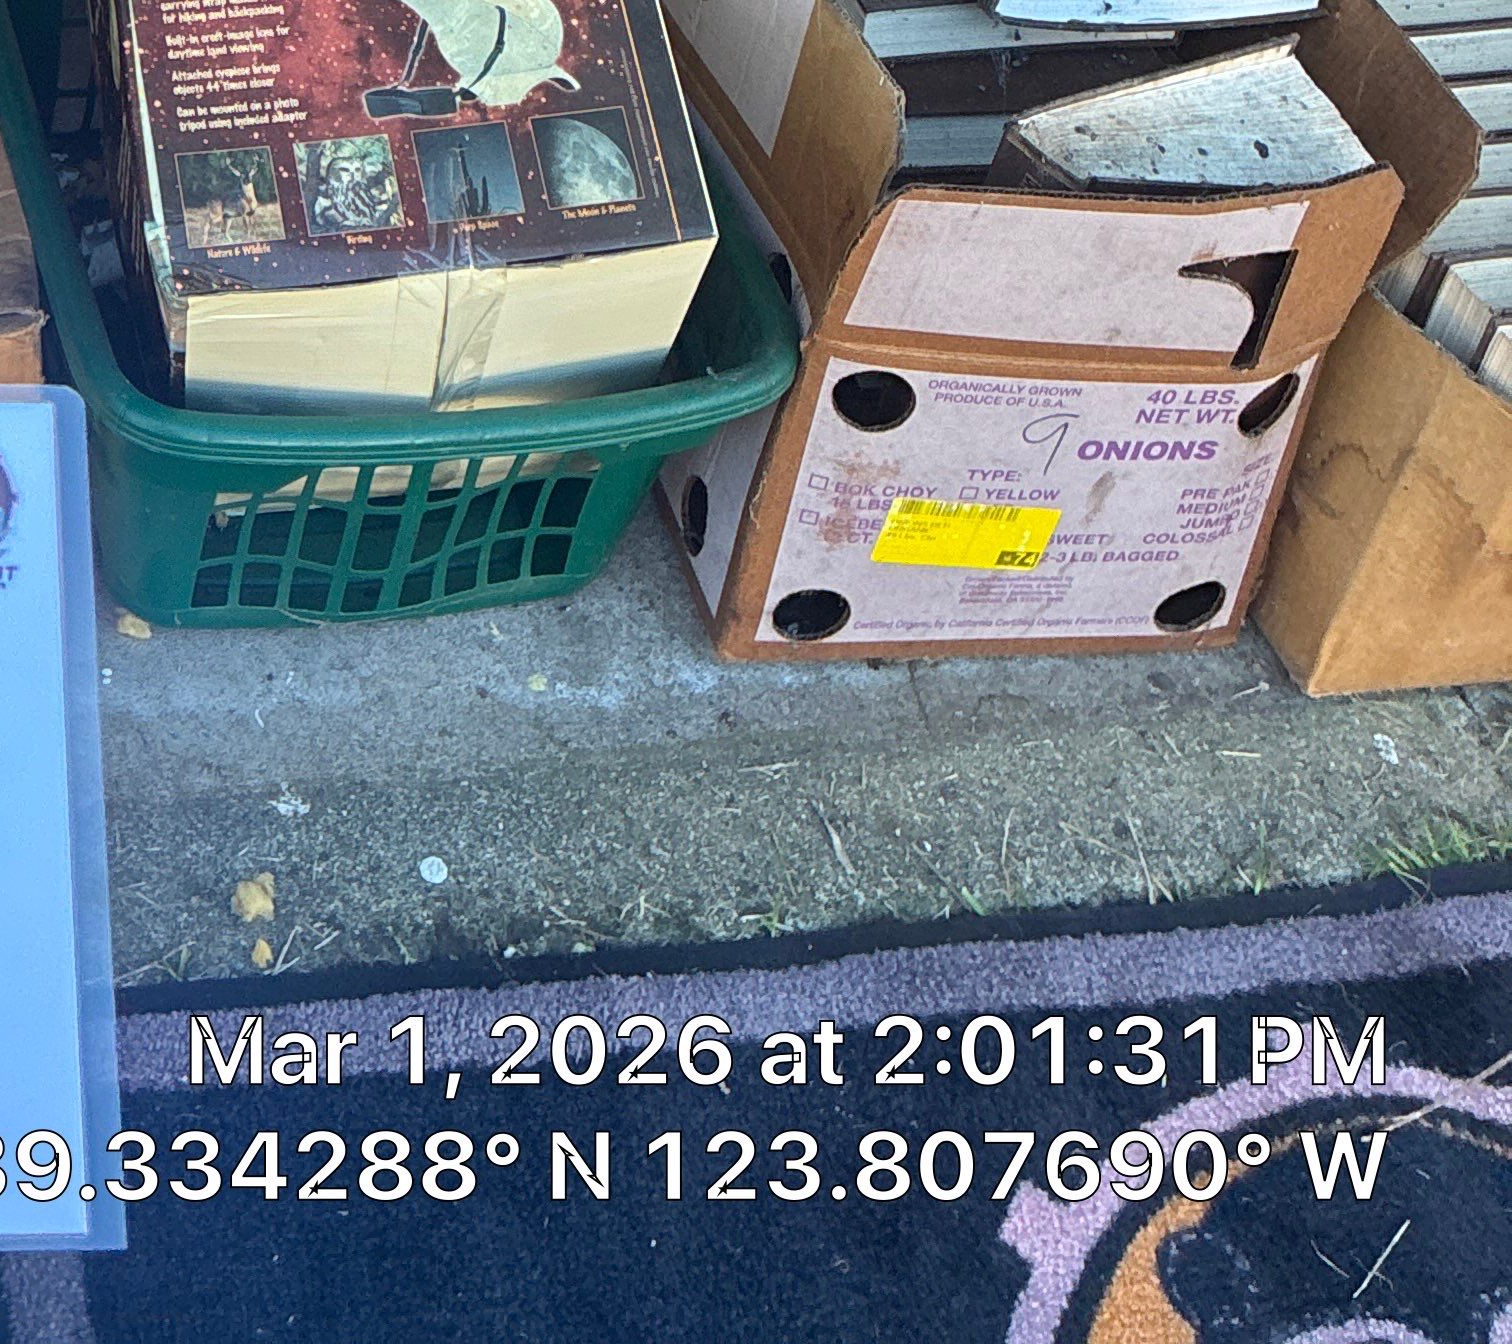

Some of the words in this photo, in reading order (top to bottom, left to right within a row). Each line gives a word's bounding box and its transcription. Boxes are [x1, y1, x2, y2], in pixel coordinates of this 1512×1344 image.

[160, 0, 201, 12] carrying
[162, 13, 176, 24] for
[178, 10, 207, 24] hiking
[208, 8, 227, 20] and
[227, 4, 285, 19] backpacking
[255, 26, 275, 38] lens
[275, 24, 291, 36] for
[167, 47, 205, 60] daytime
[206, 44, 228, 56] land
[229, 42, 265, 55] viewing
[171, 67, 213, 82] Attached
[214, 65, 251, 79] eyepiece
[251, 62, 281, 75] brings
[172, 83, 205, 97] objects
[249, 76, 276, 89] closer
[176, 106, 196, 118] Can
[196, 104, 209, 116] be
[210, 101, 248, 115] mounted
[249, 101, 262, 112] on
[263, 100, 271, 110] a
[273, 96, 300, 111] photo
[178, 119, 207, 133] tripod
[208, 117, 232, 130] using
[233, 113, 270, 127] included
[271, 110, 308, 125] adapter
[562, 209, 576, 221] The
[577, 206, 600, 219] Moon
[608, 203, 636, 216] Planets
[207, 247, 233, 260] Nature
[241, 243, 271, 257] Wildlife
[928, 379, 1025, 395] ORGANICALLY
[1028, 385, 1083, 398] GROWN
[934, 392, 1002, 407] PRODUCE
[1005, 396, 1024, 408] OF
[1146, 389, 1178, 405] 40
[1183, 389, 1240, 406] LBS.
[1135, 408, 1191, 425] NET
[1195, 408, 1237, 425] WT.
[1022, 413, 1080, 476] 9
[1076, 439, 1219, 461] ONIONS
[968, 468, 1022, 483] TYPE:
[834, 482, 876, 498] BOK
[882, 485, 938, 498] CHOY
[984, 488, 1061, 502] YELLOW
[1181, 488, 1220, 501] PRE
[1176, 493, 1246, 515] MEDIUM
[1143, 524, 1232, 545] COLOSSAL
[1102, 551, 1180, 563] BAGGED
[853, 619, 893, 631] Certified
[934, 619, 945, 630] by
[947, 616, 994, 629] California
[995, 616, 1036, 629] Certified
[1037, 615, 1073, 629] Organic
[1074, 615, 1113, 627] Farmers
